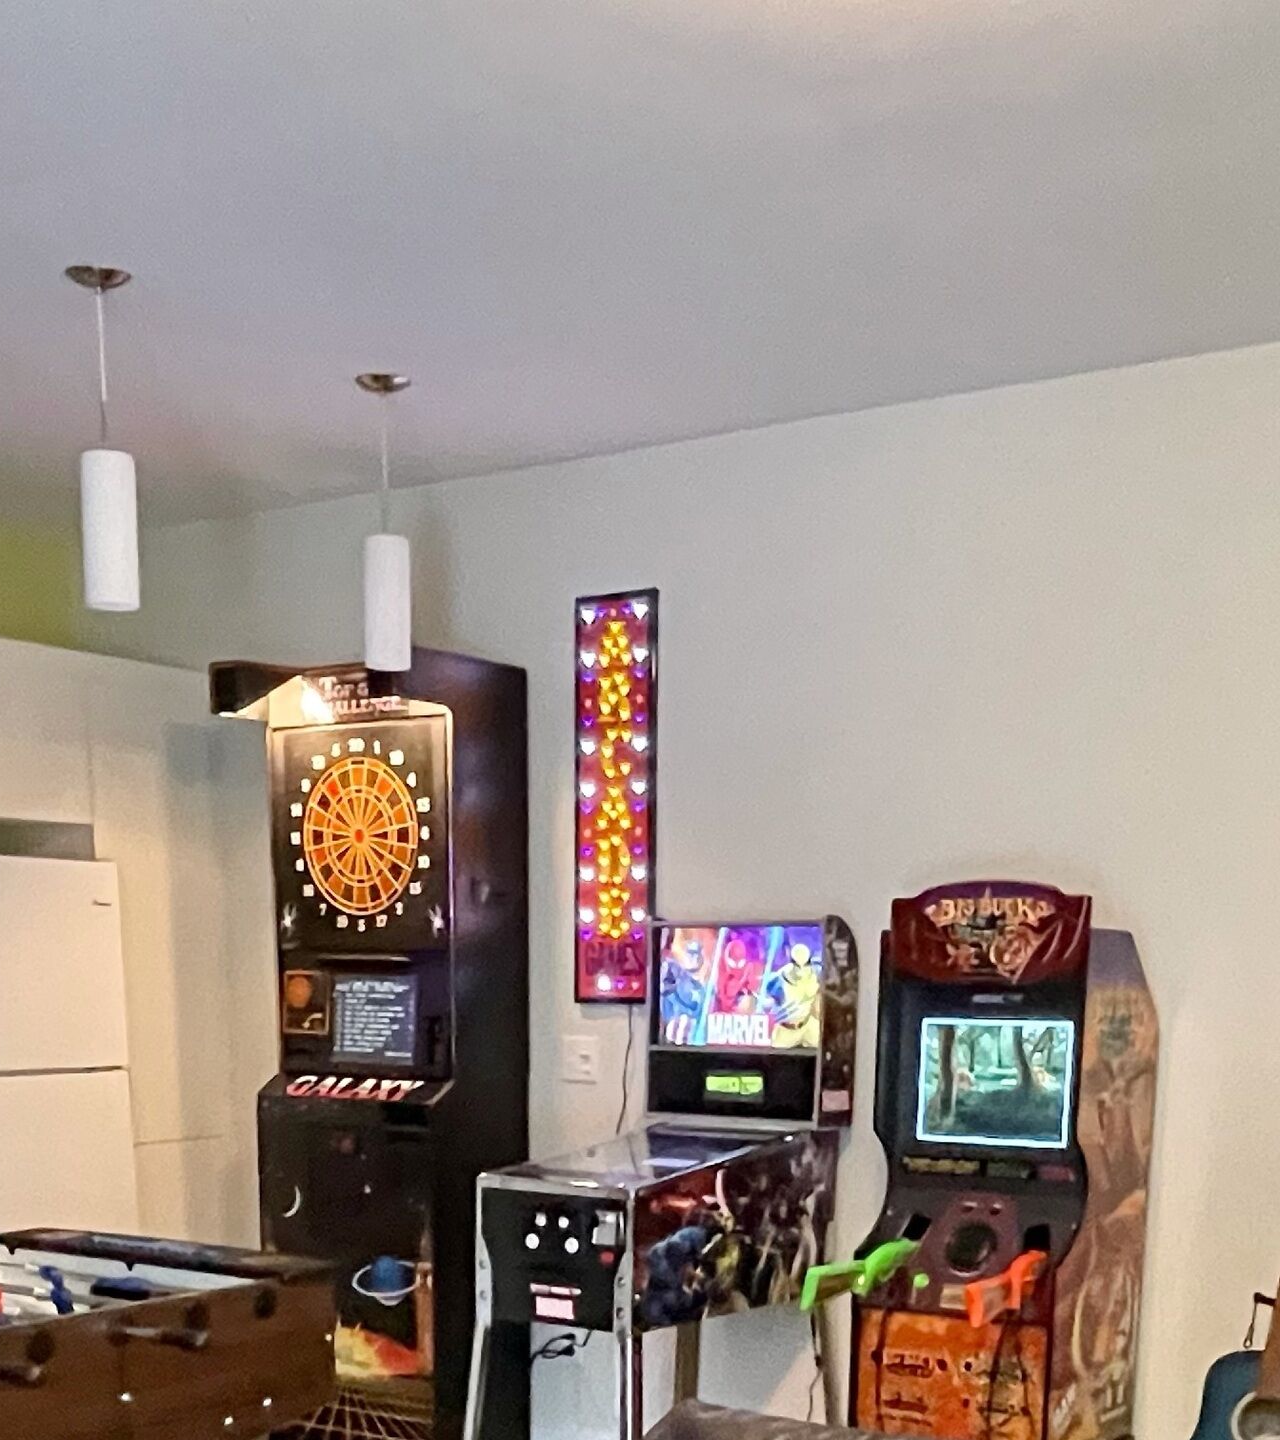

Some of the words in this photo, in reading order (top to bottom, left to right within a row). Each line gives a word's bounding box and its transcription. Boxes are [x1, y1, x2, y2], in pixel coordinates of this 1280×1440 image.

[596, 621, 632, 938] ARCADE
[707, 1013, 771, 1046] MARVEL
[286, 1075, 425, 1101] GALAXY
